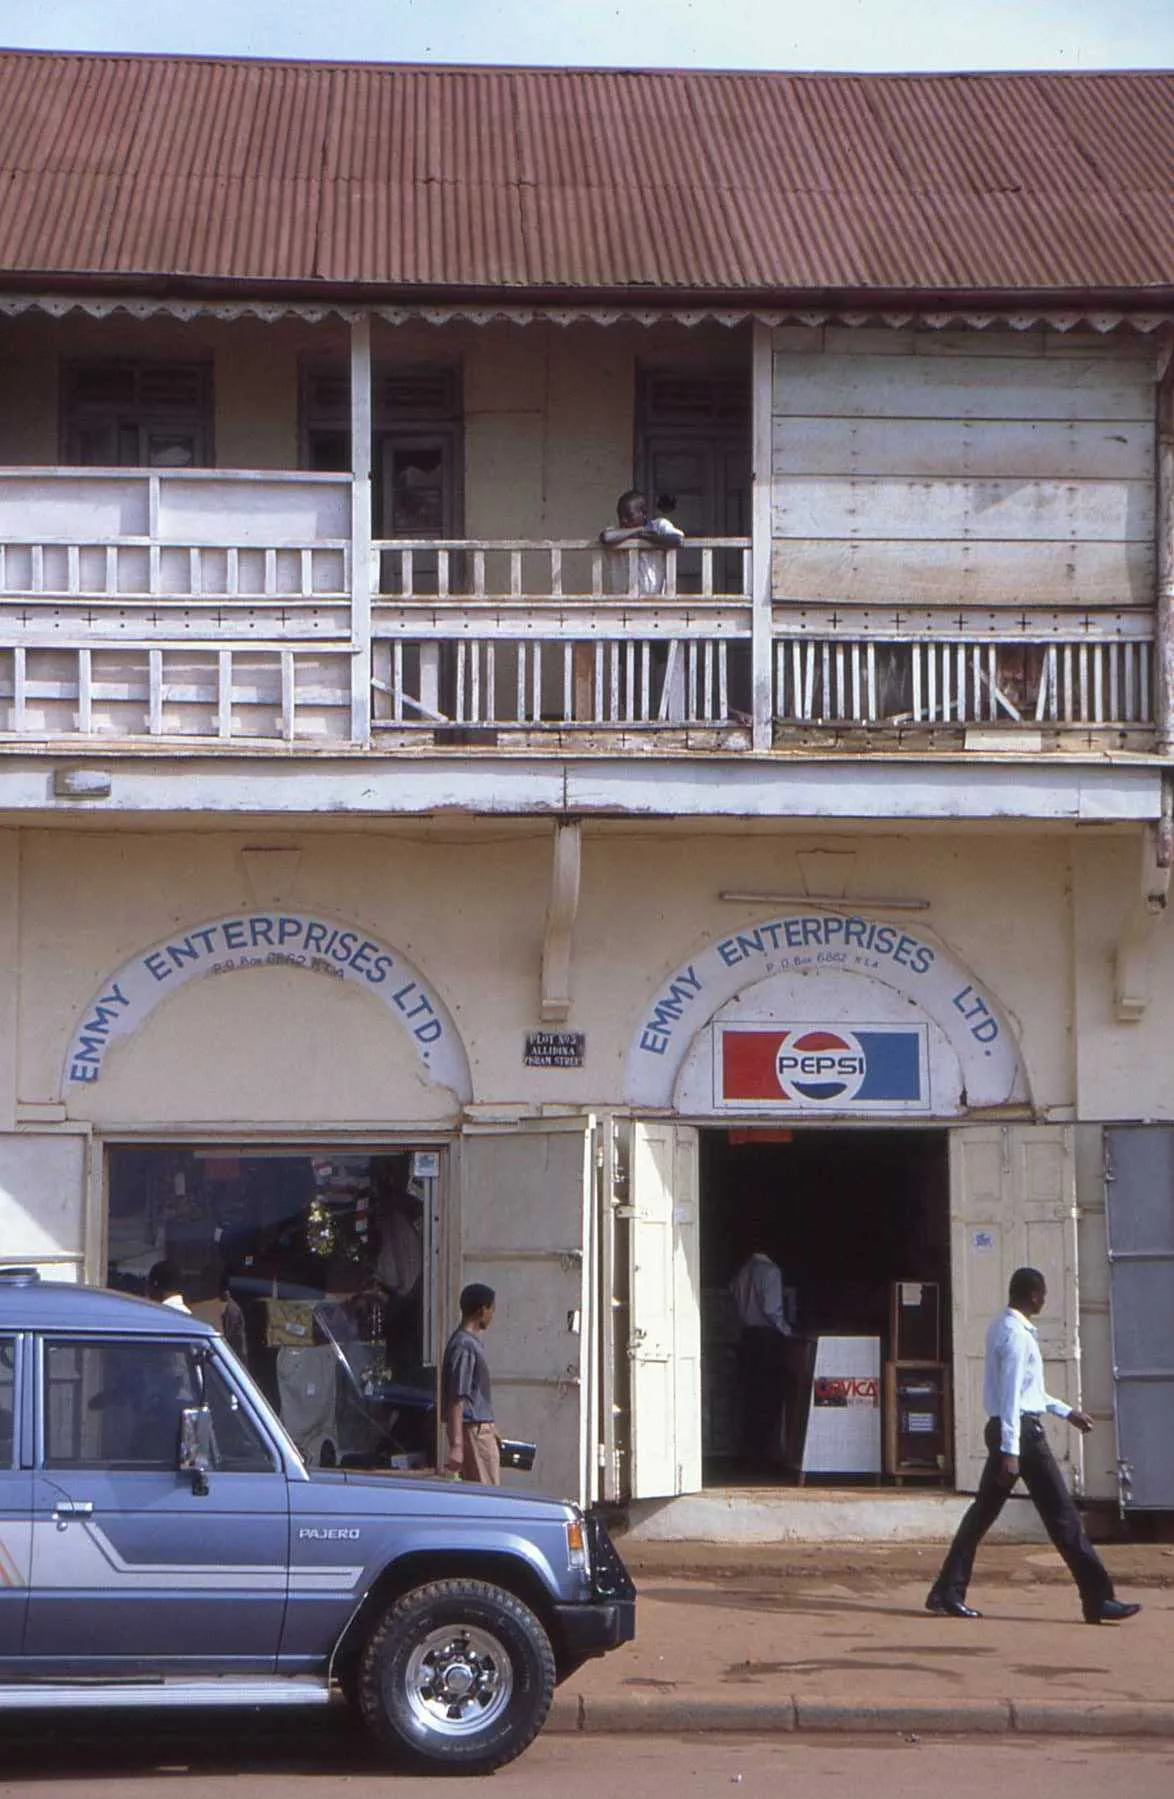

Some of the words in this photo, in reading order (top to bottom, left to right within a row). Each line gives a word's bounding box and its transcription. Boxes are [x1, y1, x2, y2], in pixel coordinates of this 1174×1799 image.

[69, 983, 131, 1083] EMMY
[143, 917, 395, 984] ENTERPRISES
[639, 966, 704, 1056] EMMY
[717, 917, 935, 975] ENTERPRISES
[778, 1056, 864, 1075] PEPSI
[299, 1528, 360, 1539] PAJERO
